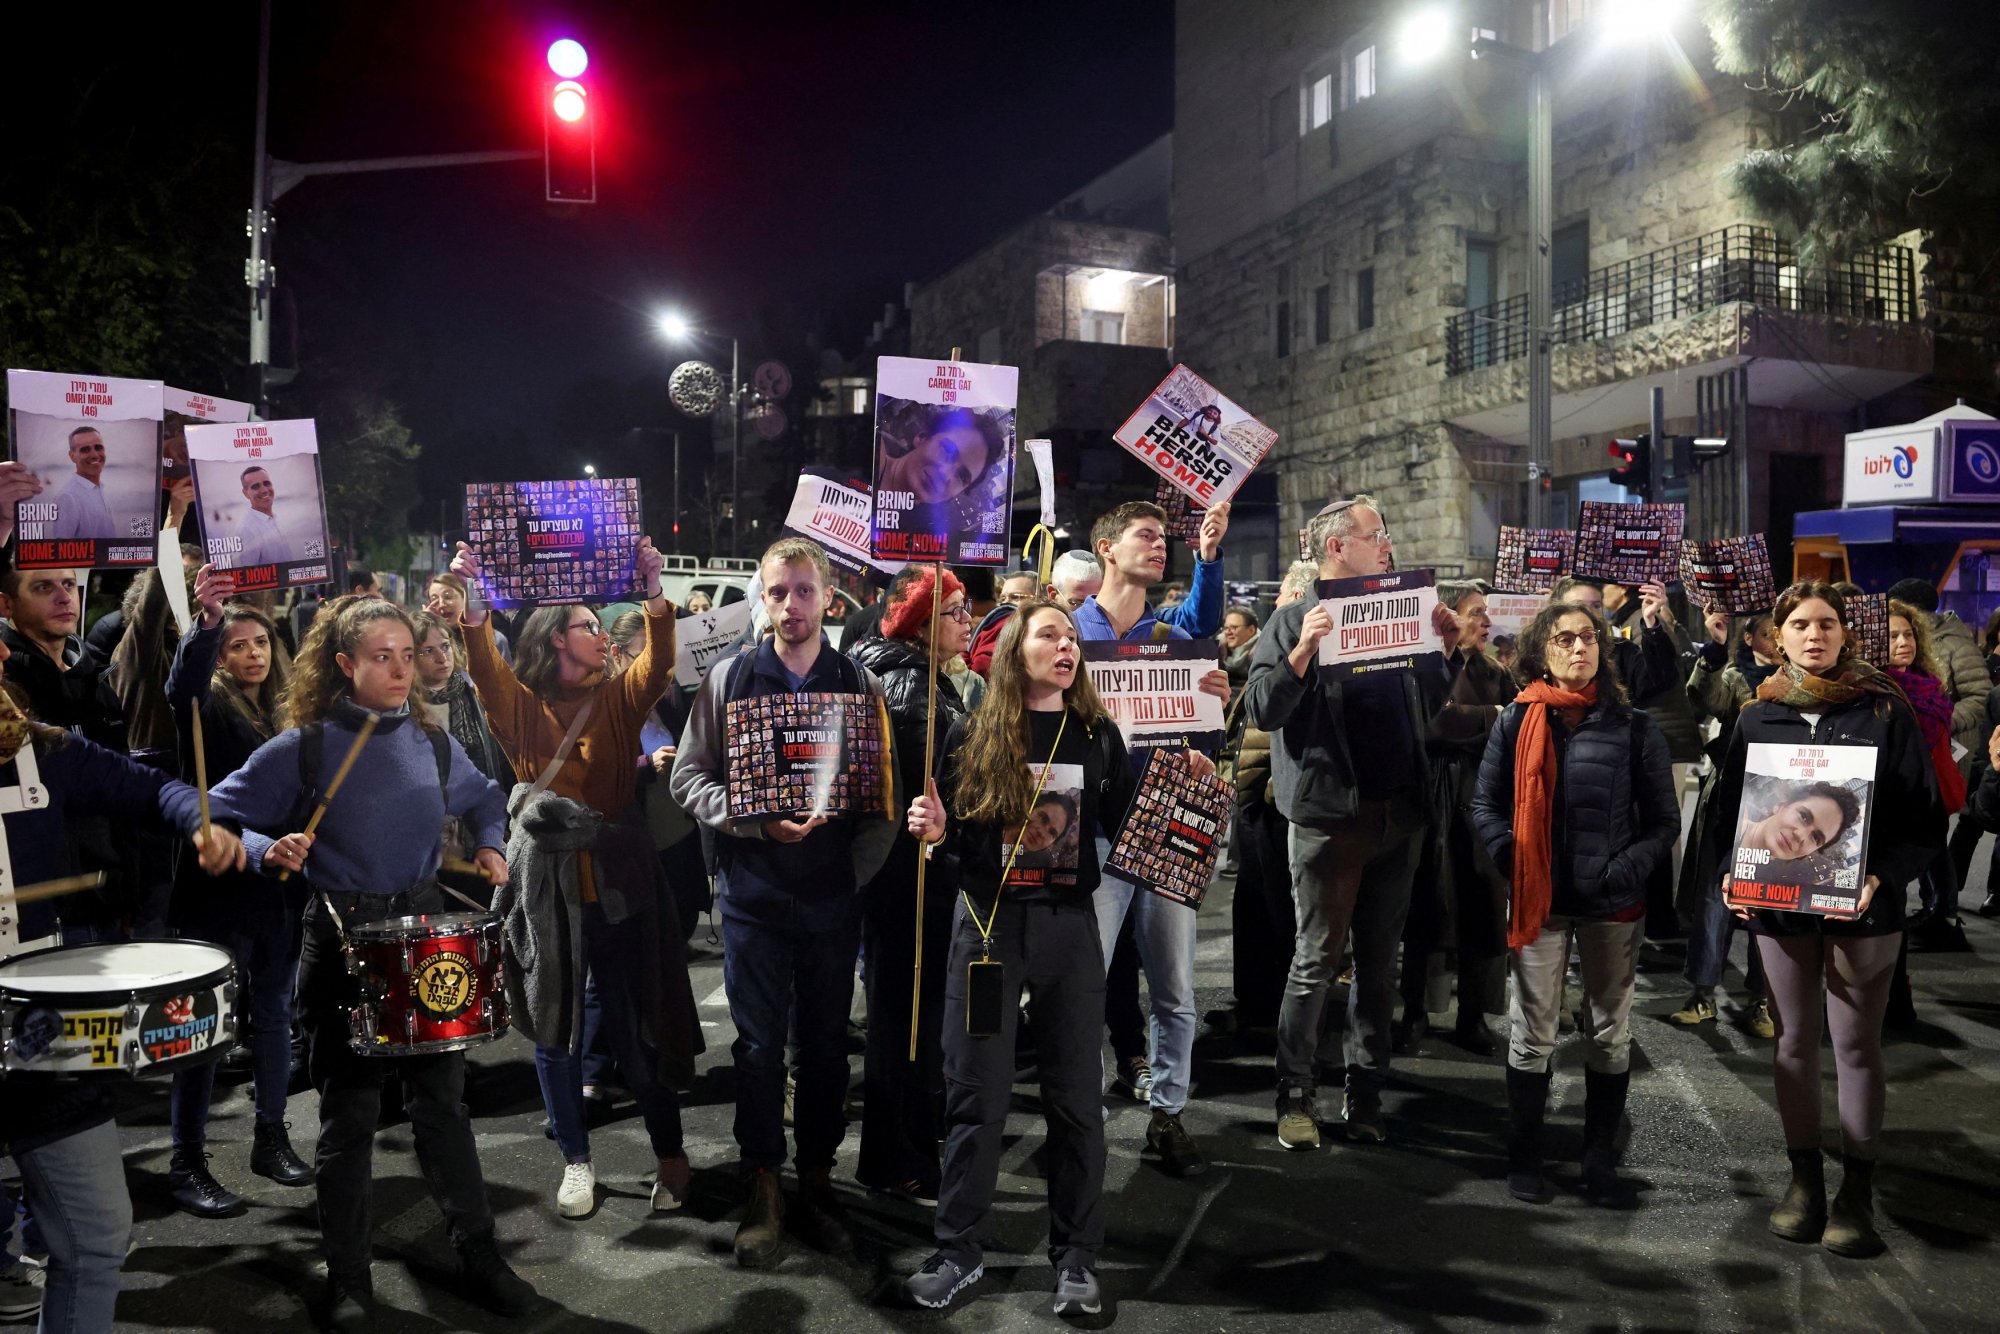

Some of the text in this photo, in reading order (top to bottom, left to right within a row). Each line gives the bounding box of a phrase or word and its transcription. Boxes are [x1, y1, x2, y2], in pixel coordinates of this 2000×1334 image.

[71, 380, 108, 393] עמרי מירן
[928, 377, 972, 391] CARMEL GAT
[65, 392, 113, 406] OMRI MIRAN
[942, 389, 957, 403] (39)
[81, 405, 98, 417] (46)
[233, 437, 274, 448] OMRI MIRAN
[1154, 414, 1232, 476] BRING
[248, 448, 262, 458] (46)
[1144, 424, 1224, 488] HERSH
[1134, 436, 1216, 500] HOME
[876, 489, 915, 511] BRING
[19, 503, 58, 521] BRING
[875, 510, 900, 529] HER
[20, 522, 45, 540] HIM
[526, 518, 584, 533] לא עוצרים עד
[875, 531, 910, 552] HOME
[912, 532, 948, 553] NOW!
[1615, 530, 1660, 540] WE WON'T STOP
[19, 539, 96, 561] HOME NOW!
[207, 536, 243, 555] BRING
[959, 548, 1004, 559] FAMILIES FORUM
[108, 552, 154, 561] FAMILIES FORUM
[210, 554, 233, 571] HIM
[246, 563, 278, 584] NOW!
[288, 569, 328, 581] FAMILIES FORUM
[1341, 596, 1419, 627] תמונת הניצחון
[1341, 620, 1420, 650] שיבת החטופים
[1148, 668, 1191, 691] תמונת
[1158, 696, 1194, 718] שיבת
[783, 730, 838, 743] לא עוצרים עד
[1789, 758, 1830, 768] CARMEL GAT
[1801, 768, 1815, 778] (39)
[1172, 805, 1184, 821] WE
[1182, 809, 1206, 831] WON'T
[1202, 819, 1217, 836] STOP
[1736, 847, 1771, 865] BRING
[1024, 869, 1045, 881] NOW!
[1734, 863, 1756, 880] HER
[1732, 881, 1800, 903] HOME NOW!
[1810, 899, 1856, 911] FAMILIES FORUM
[431, 966, 463, 987] לא
[64, 1016, 123, 1039] מקרב
[144, 1014, 216, 1045] דמוקרטיה
[93, 1037, 119, 1063] לב
[149, 1030, 209, 1061] או מרד
